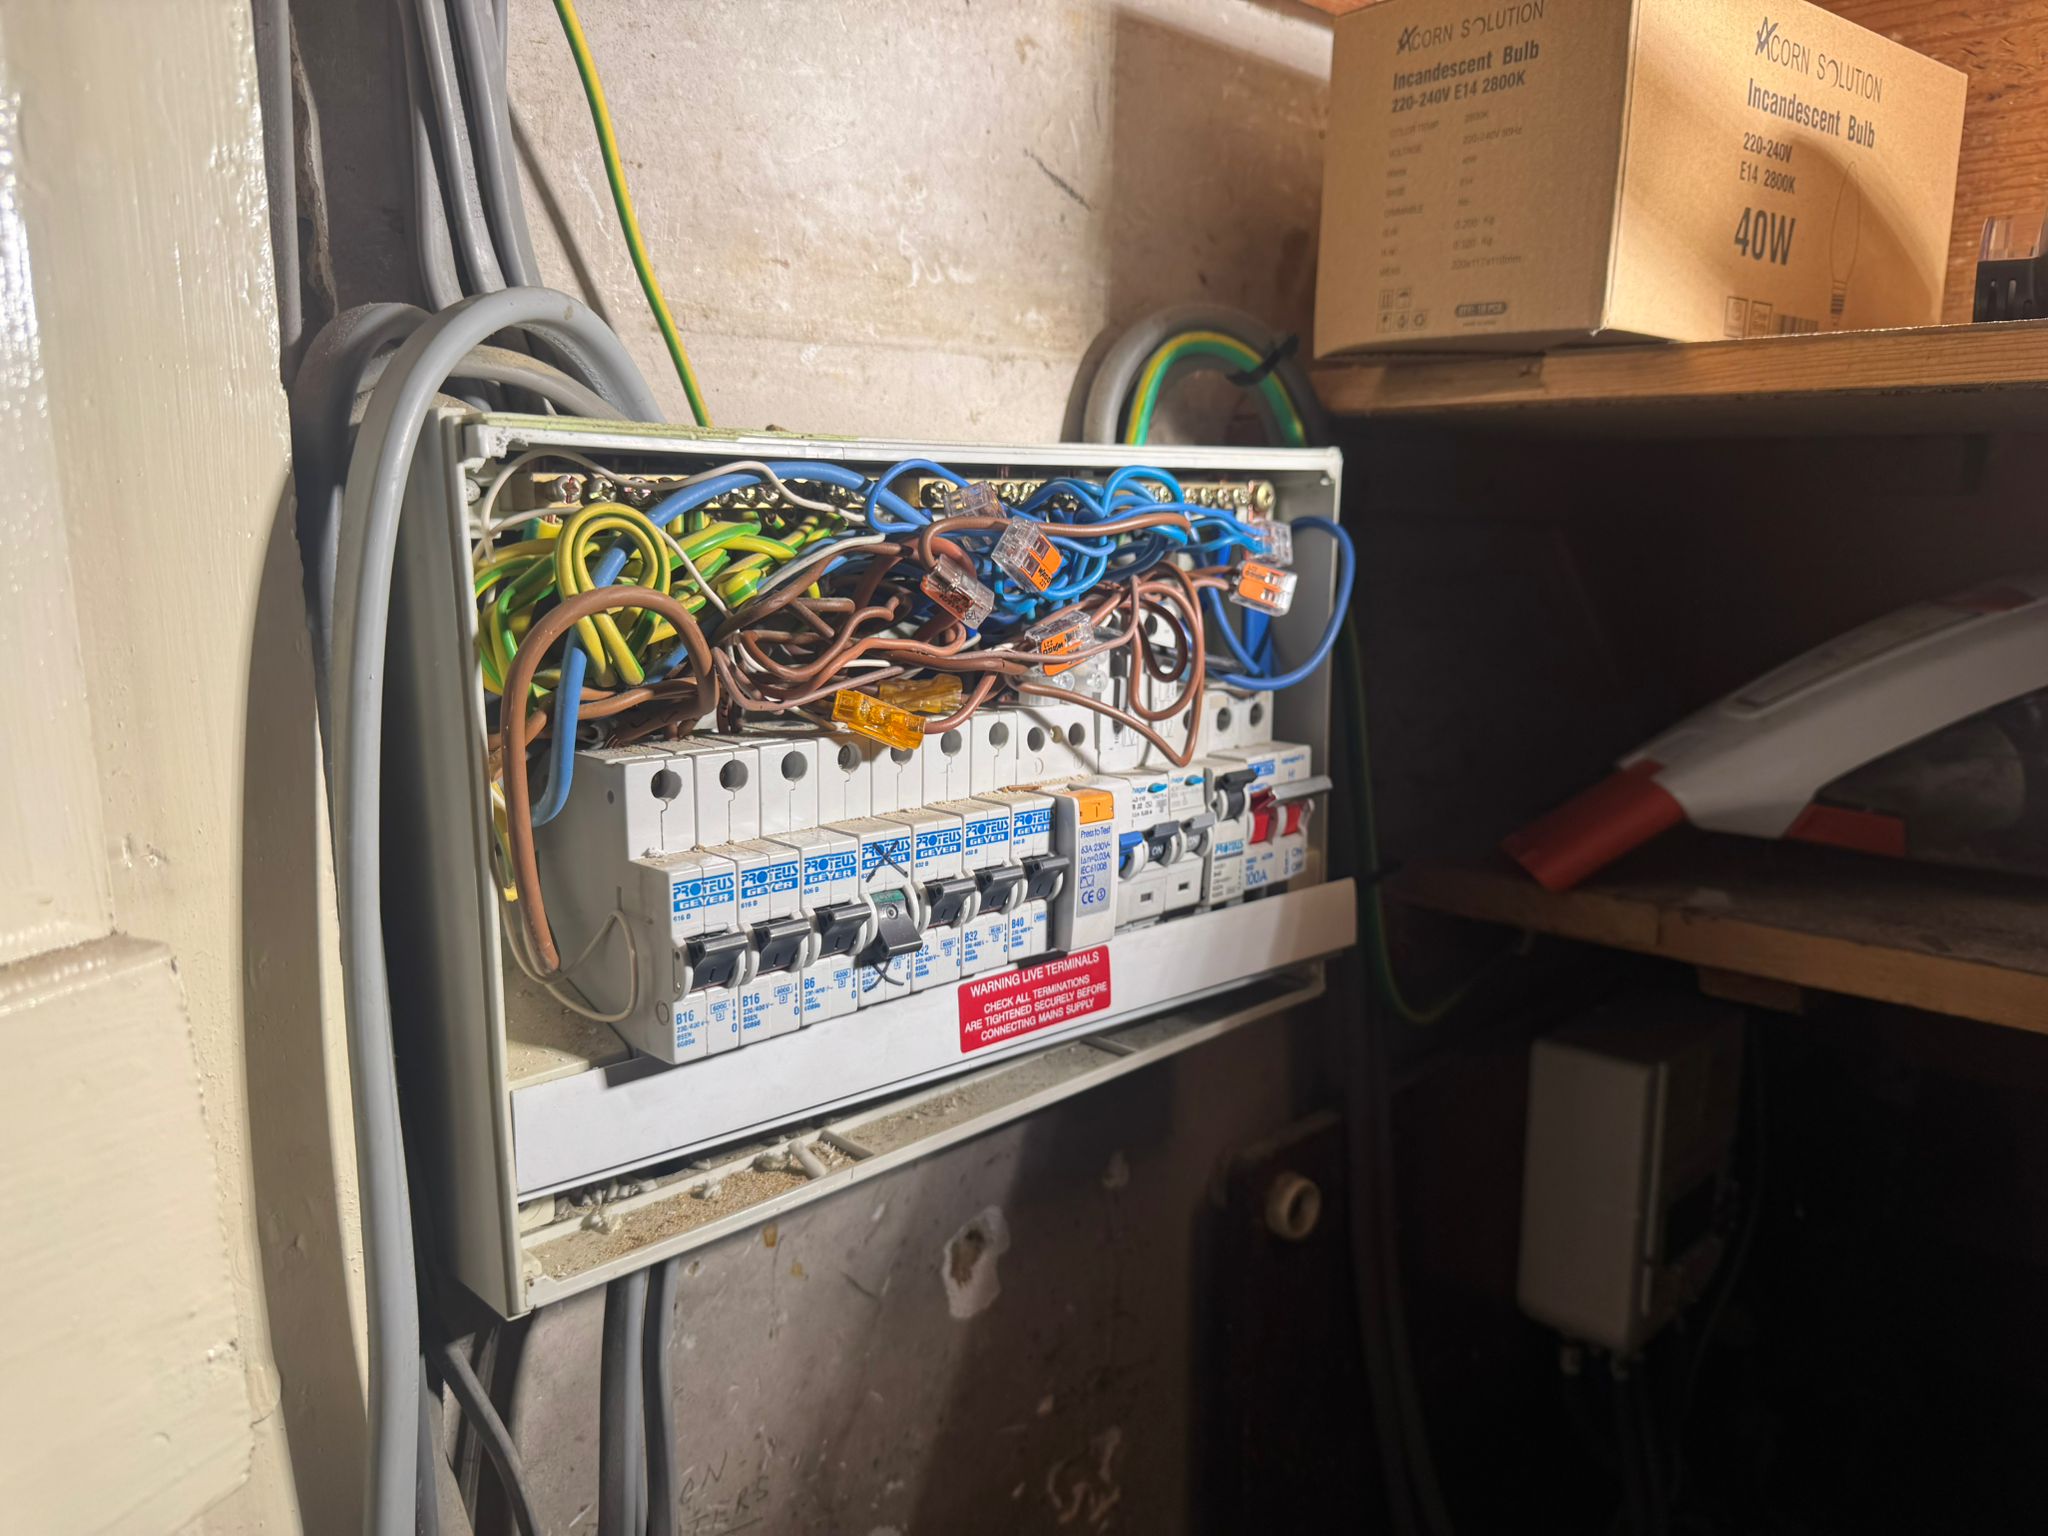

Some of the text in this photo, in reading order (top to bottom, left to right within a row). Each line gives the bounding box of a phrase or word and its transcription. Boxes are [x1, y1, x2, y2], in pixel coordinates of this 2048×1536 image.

[1396, 24, 1453, 55] ACORN
[1755, 16, 1810, 75] ACORN
[1393, 40, 1539, 91] Incandescent Bulb
[1392, 70, 1525, 113] 220-240V E14 2800K
[1747, 78, 1875, 149] Incandescent Bulb
[1743, 132, 1792, 163] 220-240V
[1740, 161, 1796, 194] E14 2800K
[1734, 207, 1796, 266] 40W
[1038, 567, 1051, 583] WAGO
[1043, 641, 1063, 654] WAGO
[966, 820, 1008, 836] PROTEUS
[1081, 826, 1111, 839] Press to Test
[916, 830, 961, 848] PROTEUS
[970, 832, 1005, 846] GEYER
[920, 844, 957, 858] GEYER
[1081, 845, 1093, 854] 63A
[1152, 844, 1163, 856] ON
[804, 854, 856, 873] PROTEUS
[741, 865, 798, 887] PROTEUS
[809, 868, 851, 883] GEYER
[673, 877, 734, 900] PROTEUS
[747, 879, 793, 897] GEYER
[681, 893, 731, 910] GEYER
[1012, 917, 1024, 928] B40
[964, 930, 977, 942] B32
[804, 977, 815, 989] B6
[970, 951, 1099, 998] WARNING LIVE TERMINALS
[742, 993, 760, 1007] B16
[984, 974, 1090, 1014] CHECK ALL TERMINATIONS
[965, 982, 1107, 1033] ARE TIGHTENED SECURELY BEFORE
[676, 1010, 694, 1025] B16
[981, 998, 1094, 1041] CONNECTING MAINS SUPPLY
